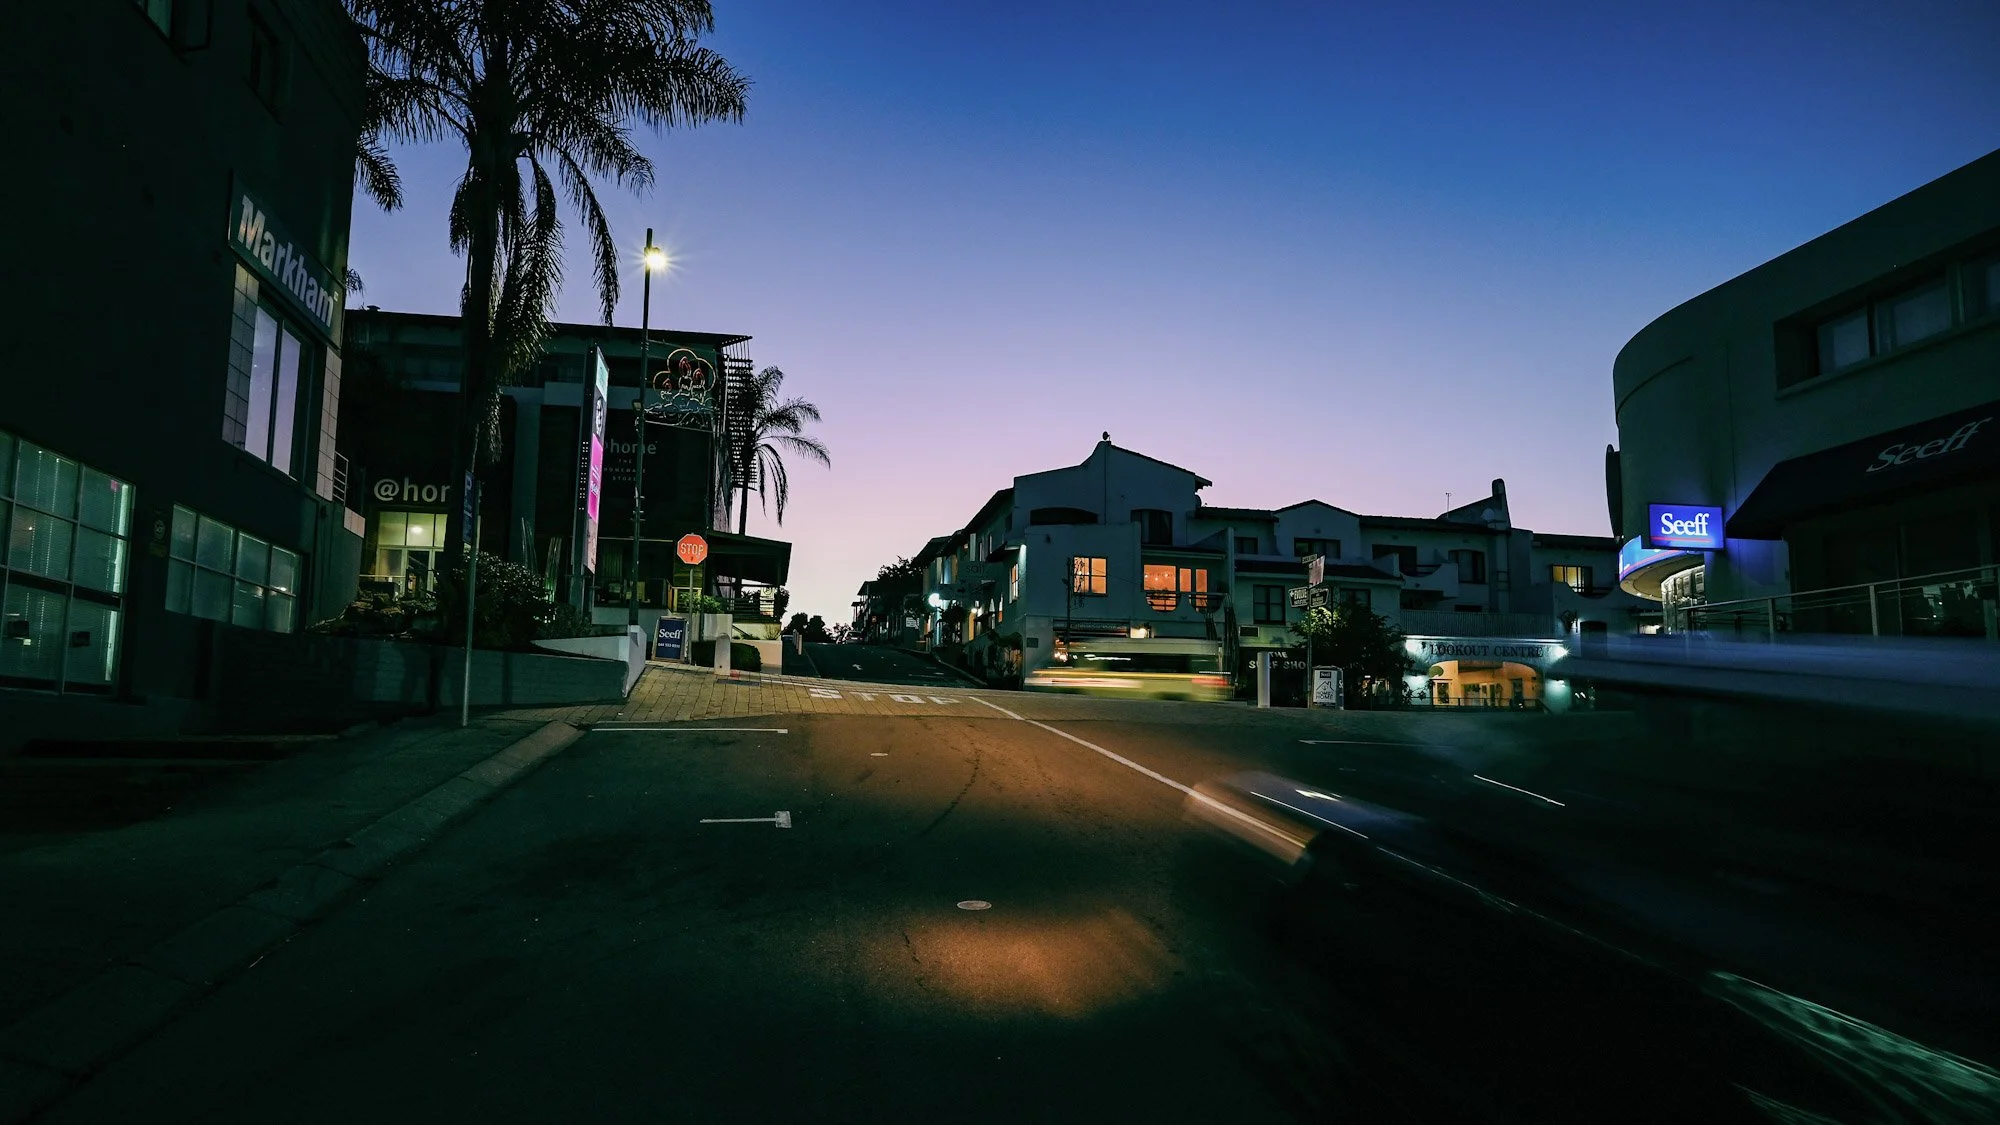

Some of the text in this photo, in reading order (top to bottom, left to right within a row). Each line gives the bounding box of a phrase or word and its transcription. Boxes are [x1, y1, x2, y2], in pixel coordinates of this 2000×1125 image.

[237, 194, 334, 328] Markham
[1865, 416, 1994, 473] Seeff
[373, 476, 451, 503] @ho
[1661, 512, 1710, 536] Seeff
[680, 543, 704, 556] STOP
[659, 628, 682, 639] Seeff
[1269, 651, 1288, 659] THE
[1430, 644, 1544, 658] LOOKOUT CENTRE
[1283, 660, 1309, 670] SHO
[808, 688, 961, 705] STOP
